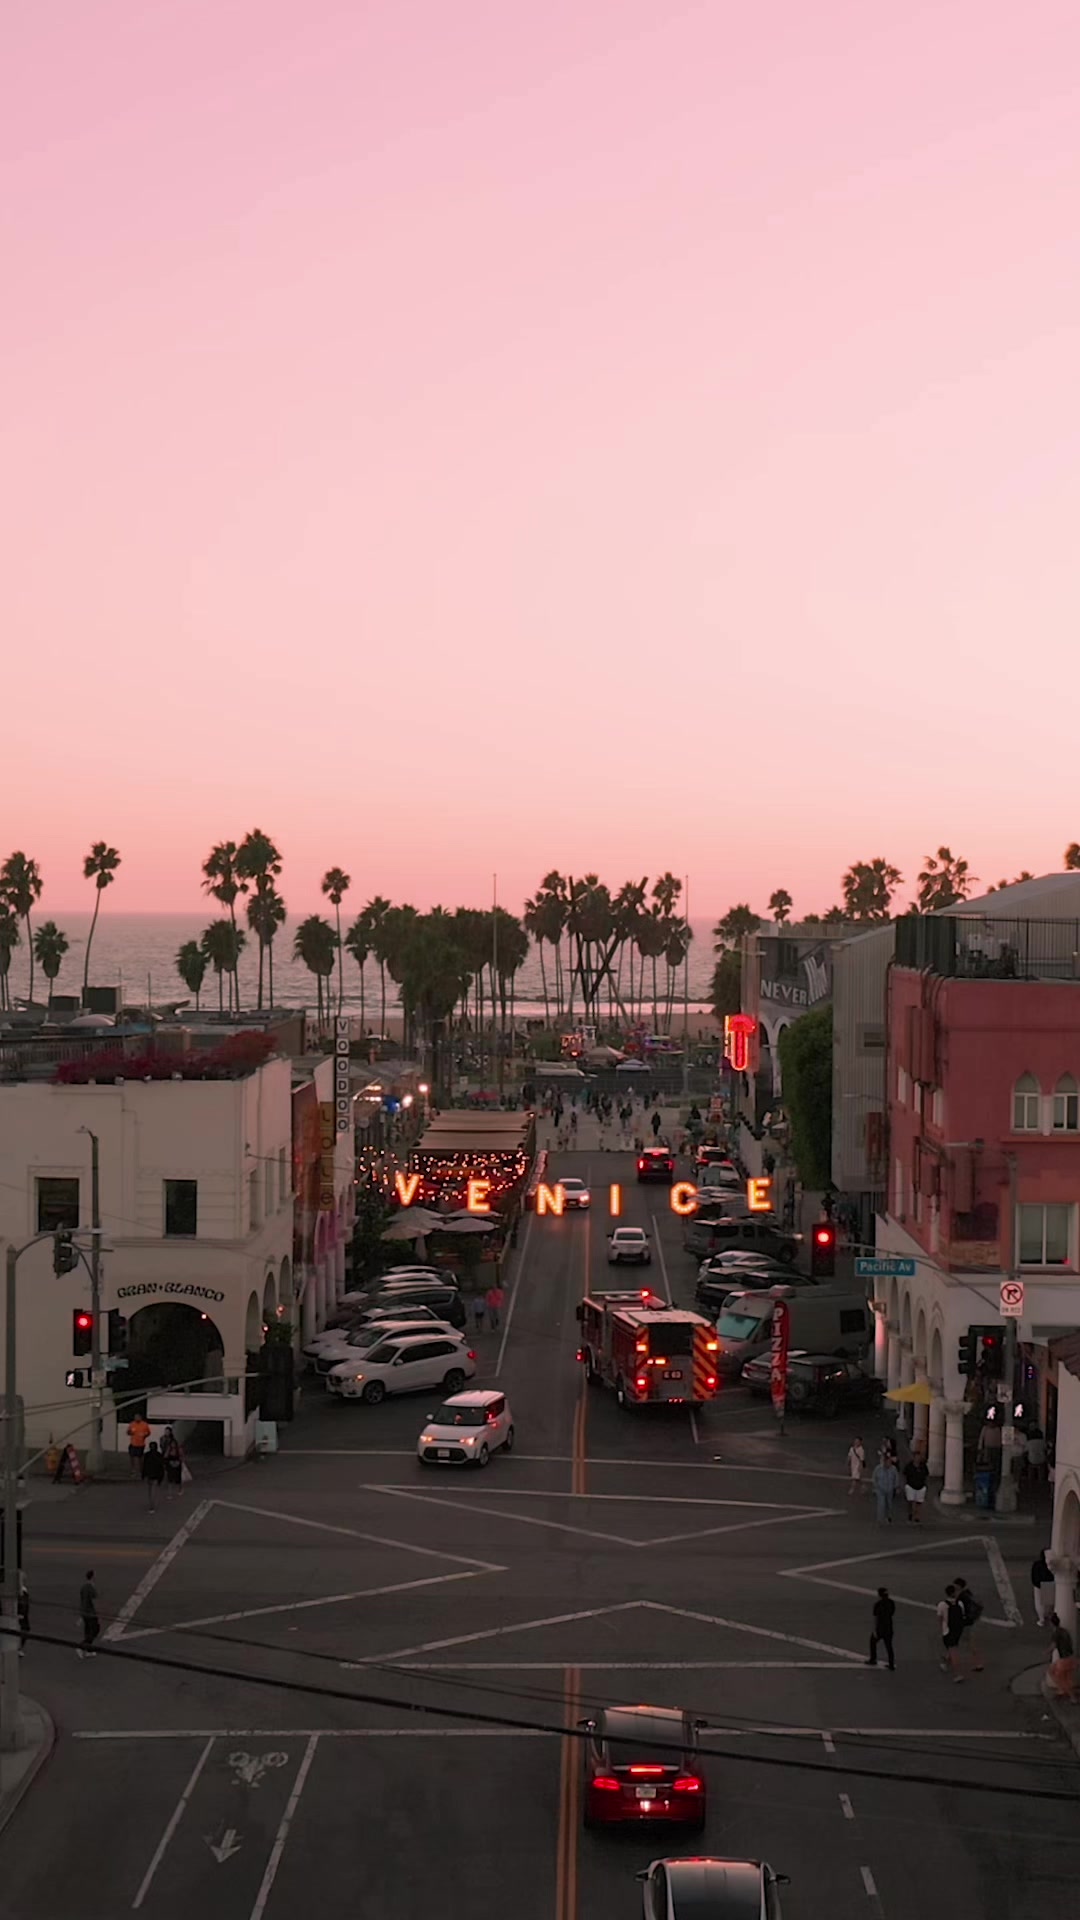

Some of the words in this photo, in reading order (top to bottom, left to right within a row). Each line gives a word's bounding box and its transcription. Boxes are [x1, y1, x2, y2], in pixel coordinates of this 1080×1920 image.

[760, 979, 807, 1005] NEVER
[337, 1020, 349, 1131] VOODOO
[395, 1175, 772, 1216] VENICE
[860, 1261, 897, 1272] Pacific
[899, 1261, 911, 1272] Av
[117, 1282, 158, 1298] GRAN
[164, 1282, 225, 1302] BLANCO
[771, 1306, 784, 1381] PIZZA
